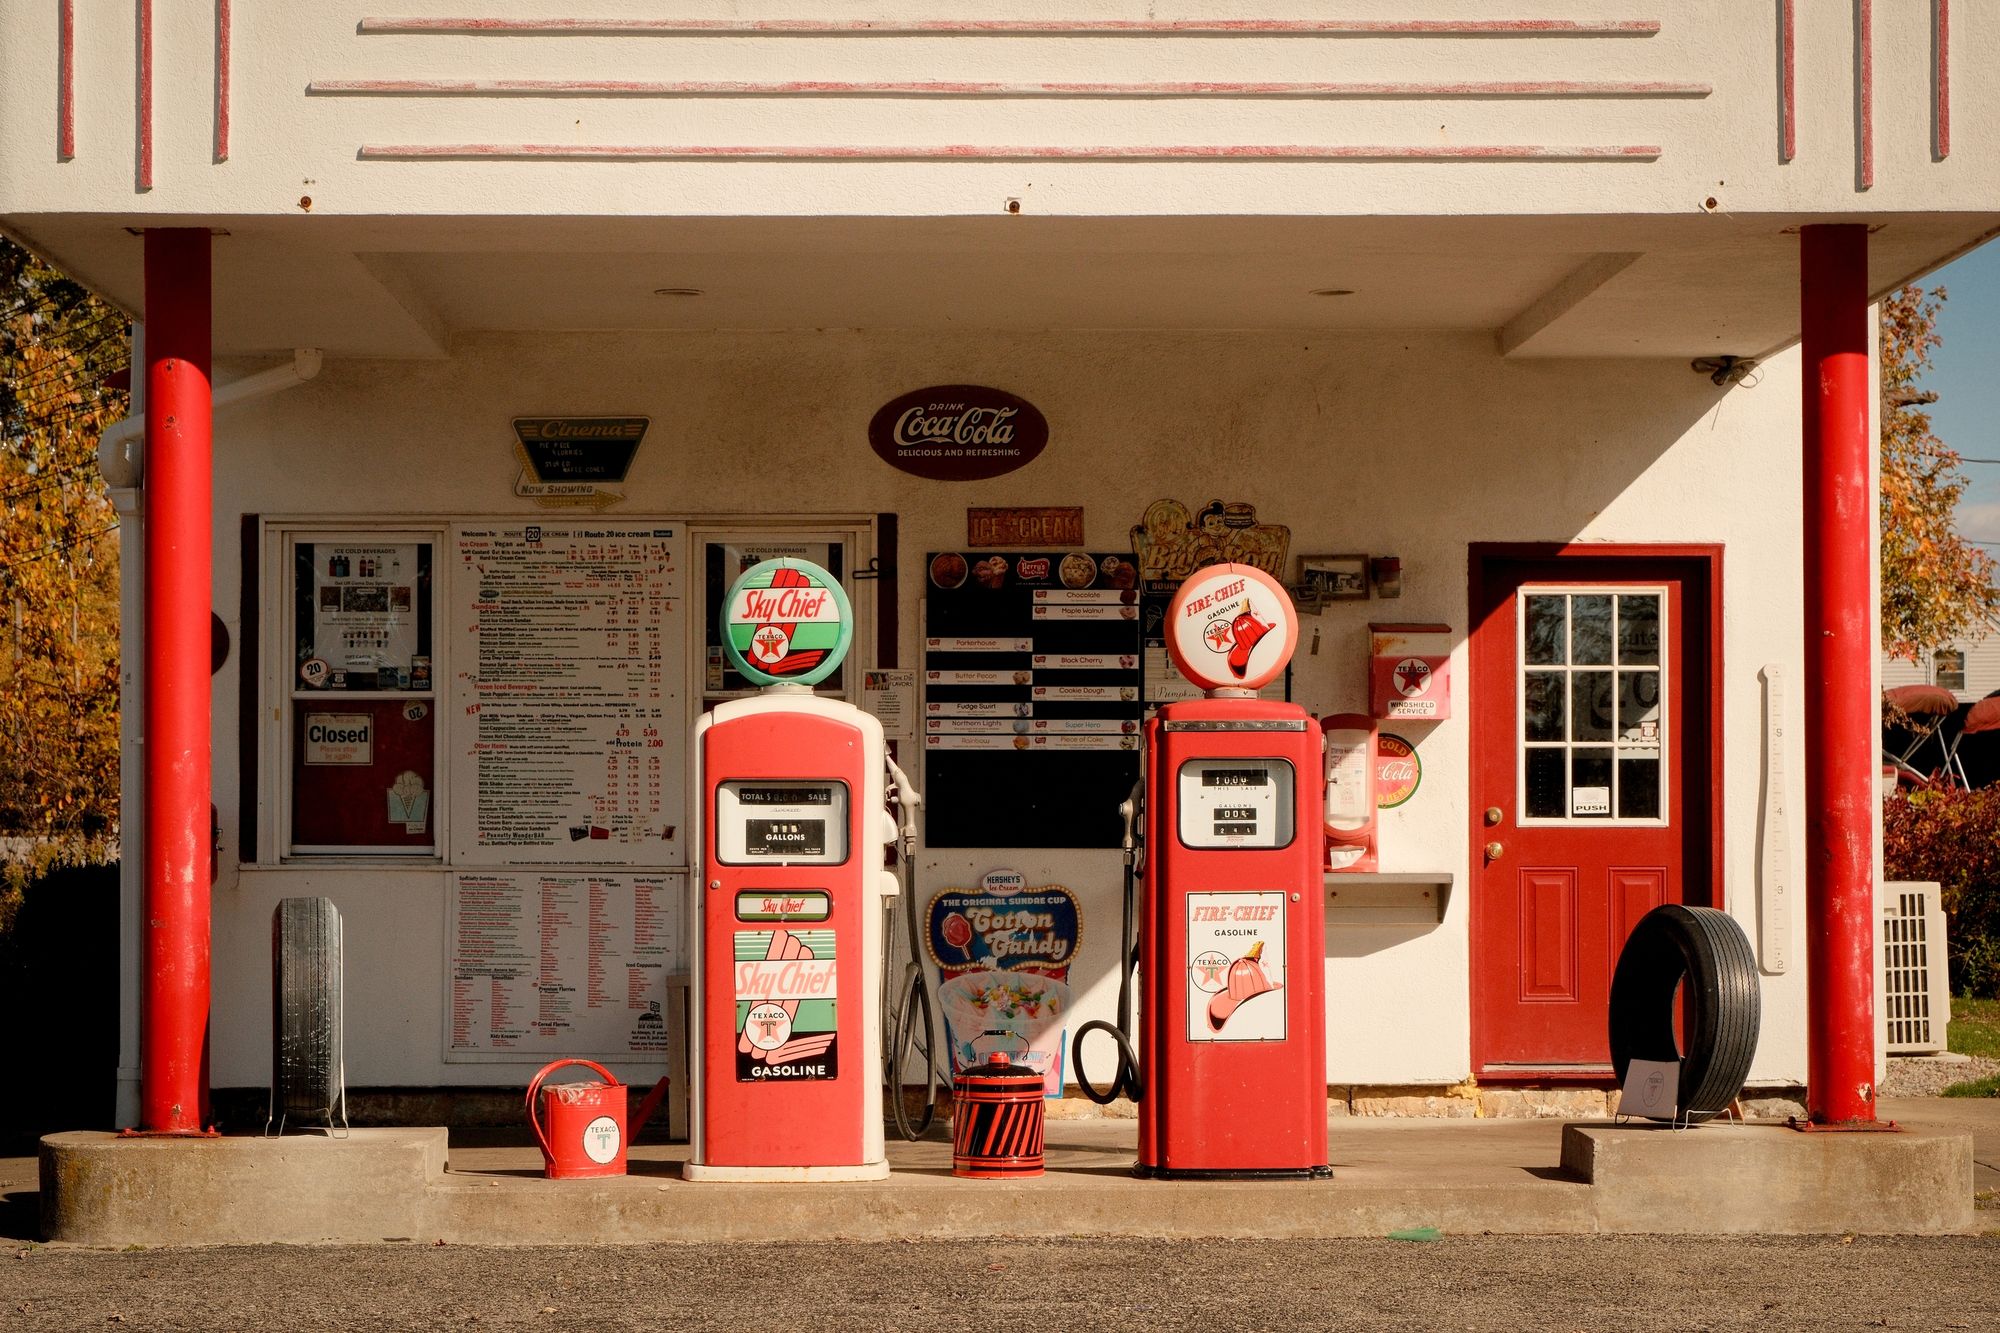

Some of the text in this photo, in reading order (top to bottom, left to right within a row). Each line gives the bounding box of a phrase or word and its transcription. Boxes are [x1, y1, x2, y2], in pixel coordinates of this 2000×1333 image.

[541, 421, 624, 438] Cinema
[893, 406, 1019, 446] Coca-Cola
[521, 485, 592, 494] NOW SHOWING
[974, 516, 1081, 538] ICE CREAM
[742, 590, 777, 622] Sky
[777, 589, 827, 617] Chief
[1186, 579, 1246, 617] FIRE-CHIEF
[1207, 601, 1239, 620] GASOLINE
[1206, 622, 1229, 635] TEXACO
[307, 663, 321, 675] 20
[466, 703, 481, 715] NEW
[310, 725, 368, 742] Closed
[616, 738, 663, 748] Protein 2.00
[986, 876, 1020, 884] HERSHEY'S
[761, 899, 778, 914] Sky
[780, 898, 805, 912] Chief
[942, 896, 1066, 907] THE ORIGINAL SUNDAE CUP
[965, 907, 1055, 932] Cotton
[1193, 906, 1278, 921] FIRE-CHIEF
[984, 930, 1068, 959] Candy
[736, 961, 778, 999] Sky
[778, 961, 836, 994] Chief
[751, 1065, 825, 1077] GASOLINE
